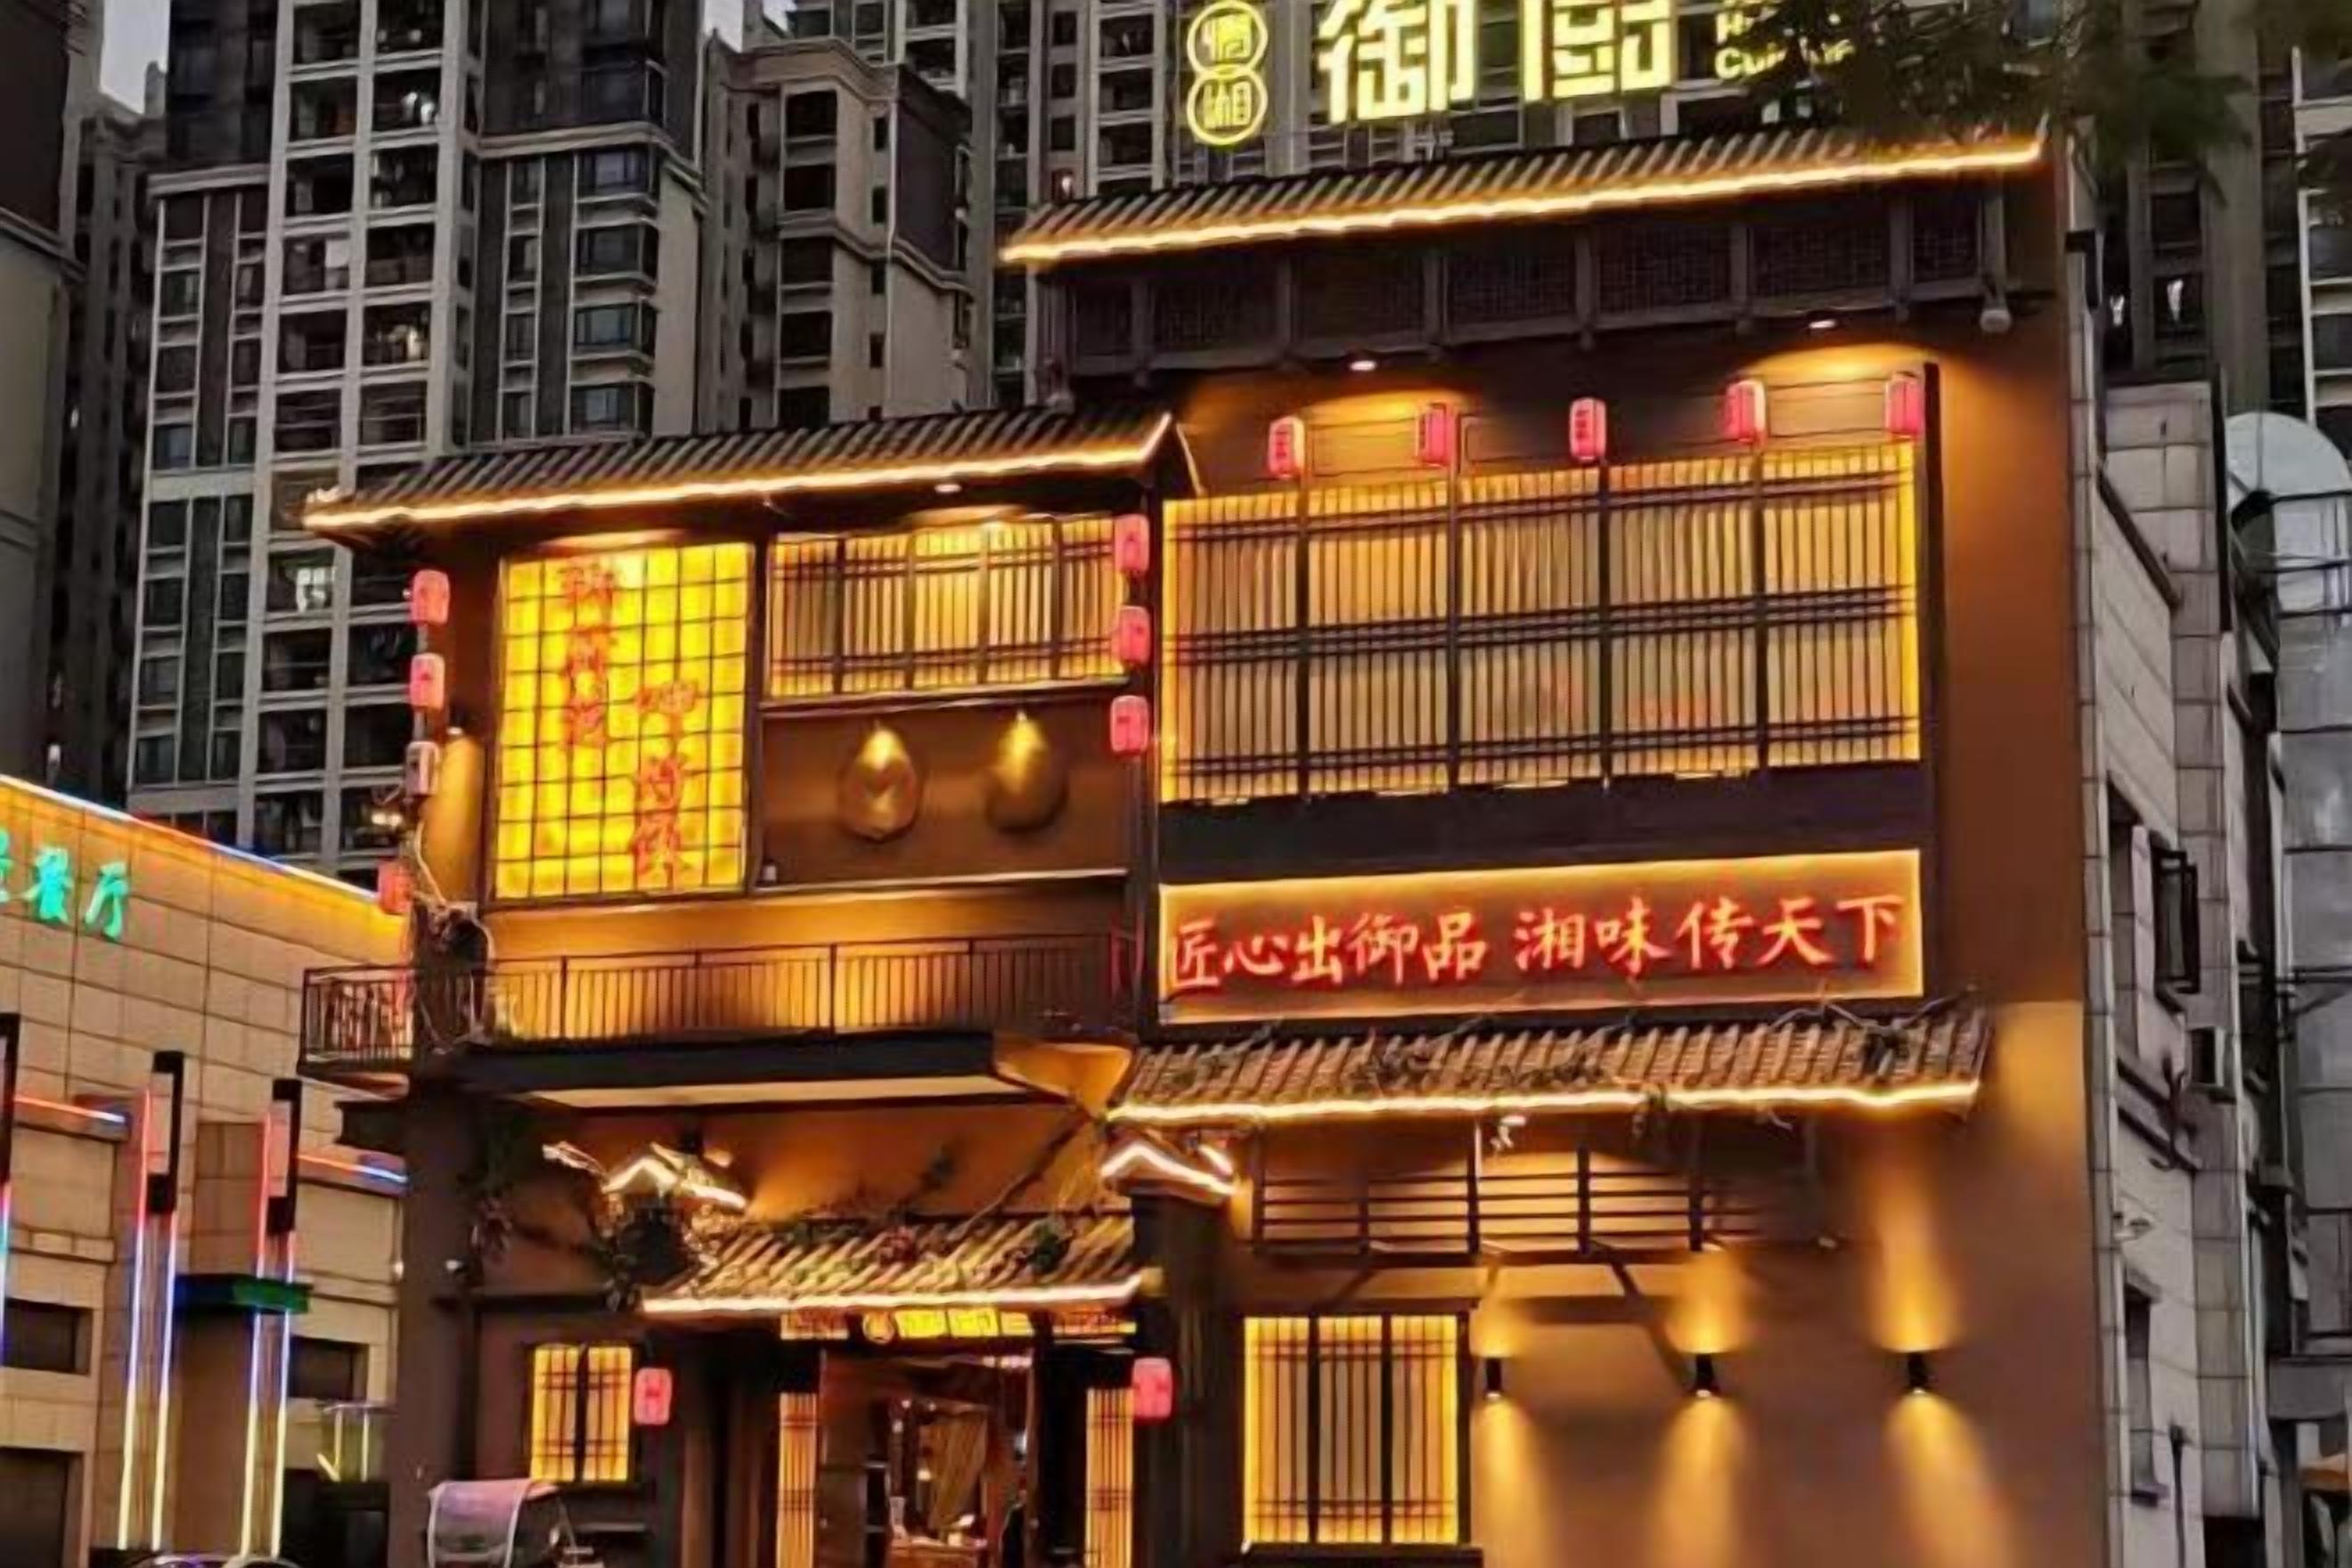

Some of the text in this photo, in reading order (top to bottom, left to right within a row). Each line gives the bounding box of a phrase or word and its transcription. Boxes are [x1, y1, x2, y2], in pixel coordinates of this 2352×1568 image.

[1172, 894, 1905, 986] 匠心出御品 湘味传天下
